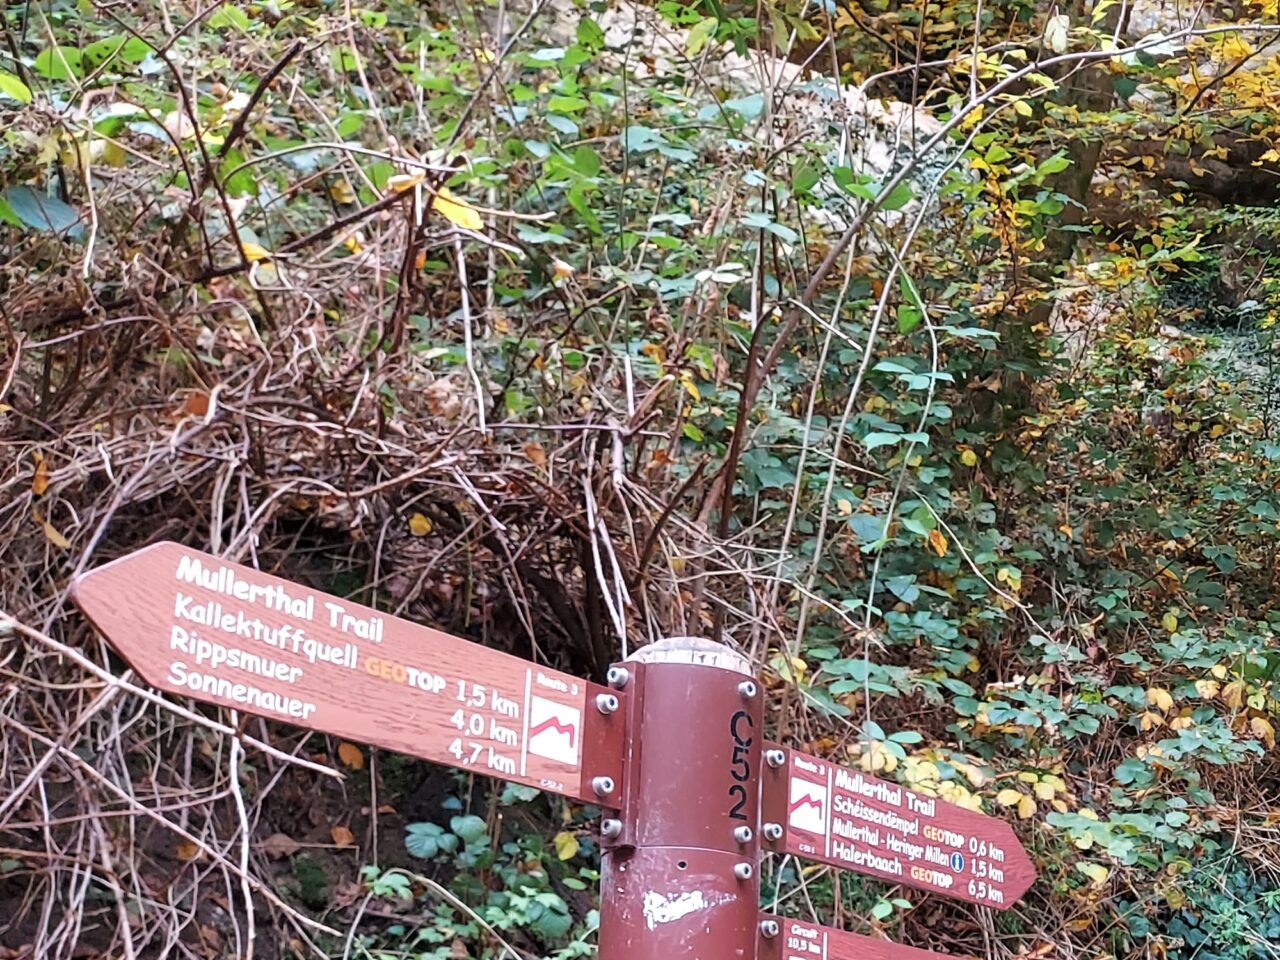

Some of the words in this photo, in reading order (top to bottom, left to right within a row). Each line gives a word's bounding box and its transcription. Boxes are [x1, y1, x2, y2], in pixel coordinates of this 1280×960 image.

[177, 555, 314, 620] Mullerthal
[324, 602, 384, 643] Trail
[170, 626, 303, 684] Rippsmuer
[451, 709, 485, 738] 4,0
[488, 719, 518, 747] km
[175, 593, 358, 670] Kallektuffquell
[364, 657, 446, 694] GEOTOP
[457, 679, 487, 709] 1,5
[490, 687, 520, 718] km
[537, 672, 568, 692] Route
[168, 661, 316, 720] Sonnenauer
[449, 740, 482, 767] 4,7
[485, 748, 516, 776] km
[835, 770, 901, 807] Mullerthal
[906, 791, 935, 818] Trail
[832, 820, 879, 845] Mullerthal
[886, 835, 924, 862] Heringer
[925, 845, 949, 866] Millen
[970, 859, 986, 878] 1,5
[987, 863, 1004, 882] km
[834, 797, 919, 836] Schéissendëmpel
[923, 825, 964, 848] GEOTOP
[969, 837, 986, 856] 0,6
[987, 841, 1004, 862] km
[833, 842, 902, 875] Halerbaach
[911, 866, 953, 889] GEOTOP
[968, 880, 985, 900] 6,5
[987, 884, 1003, 904] km
[788, 937, 807, 951] 10,5
